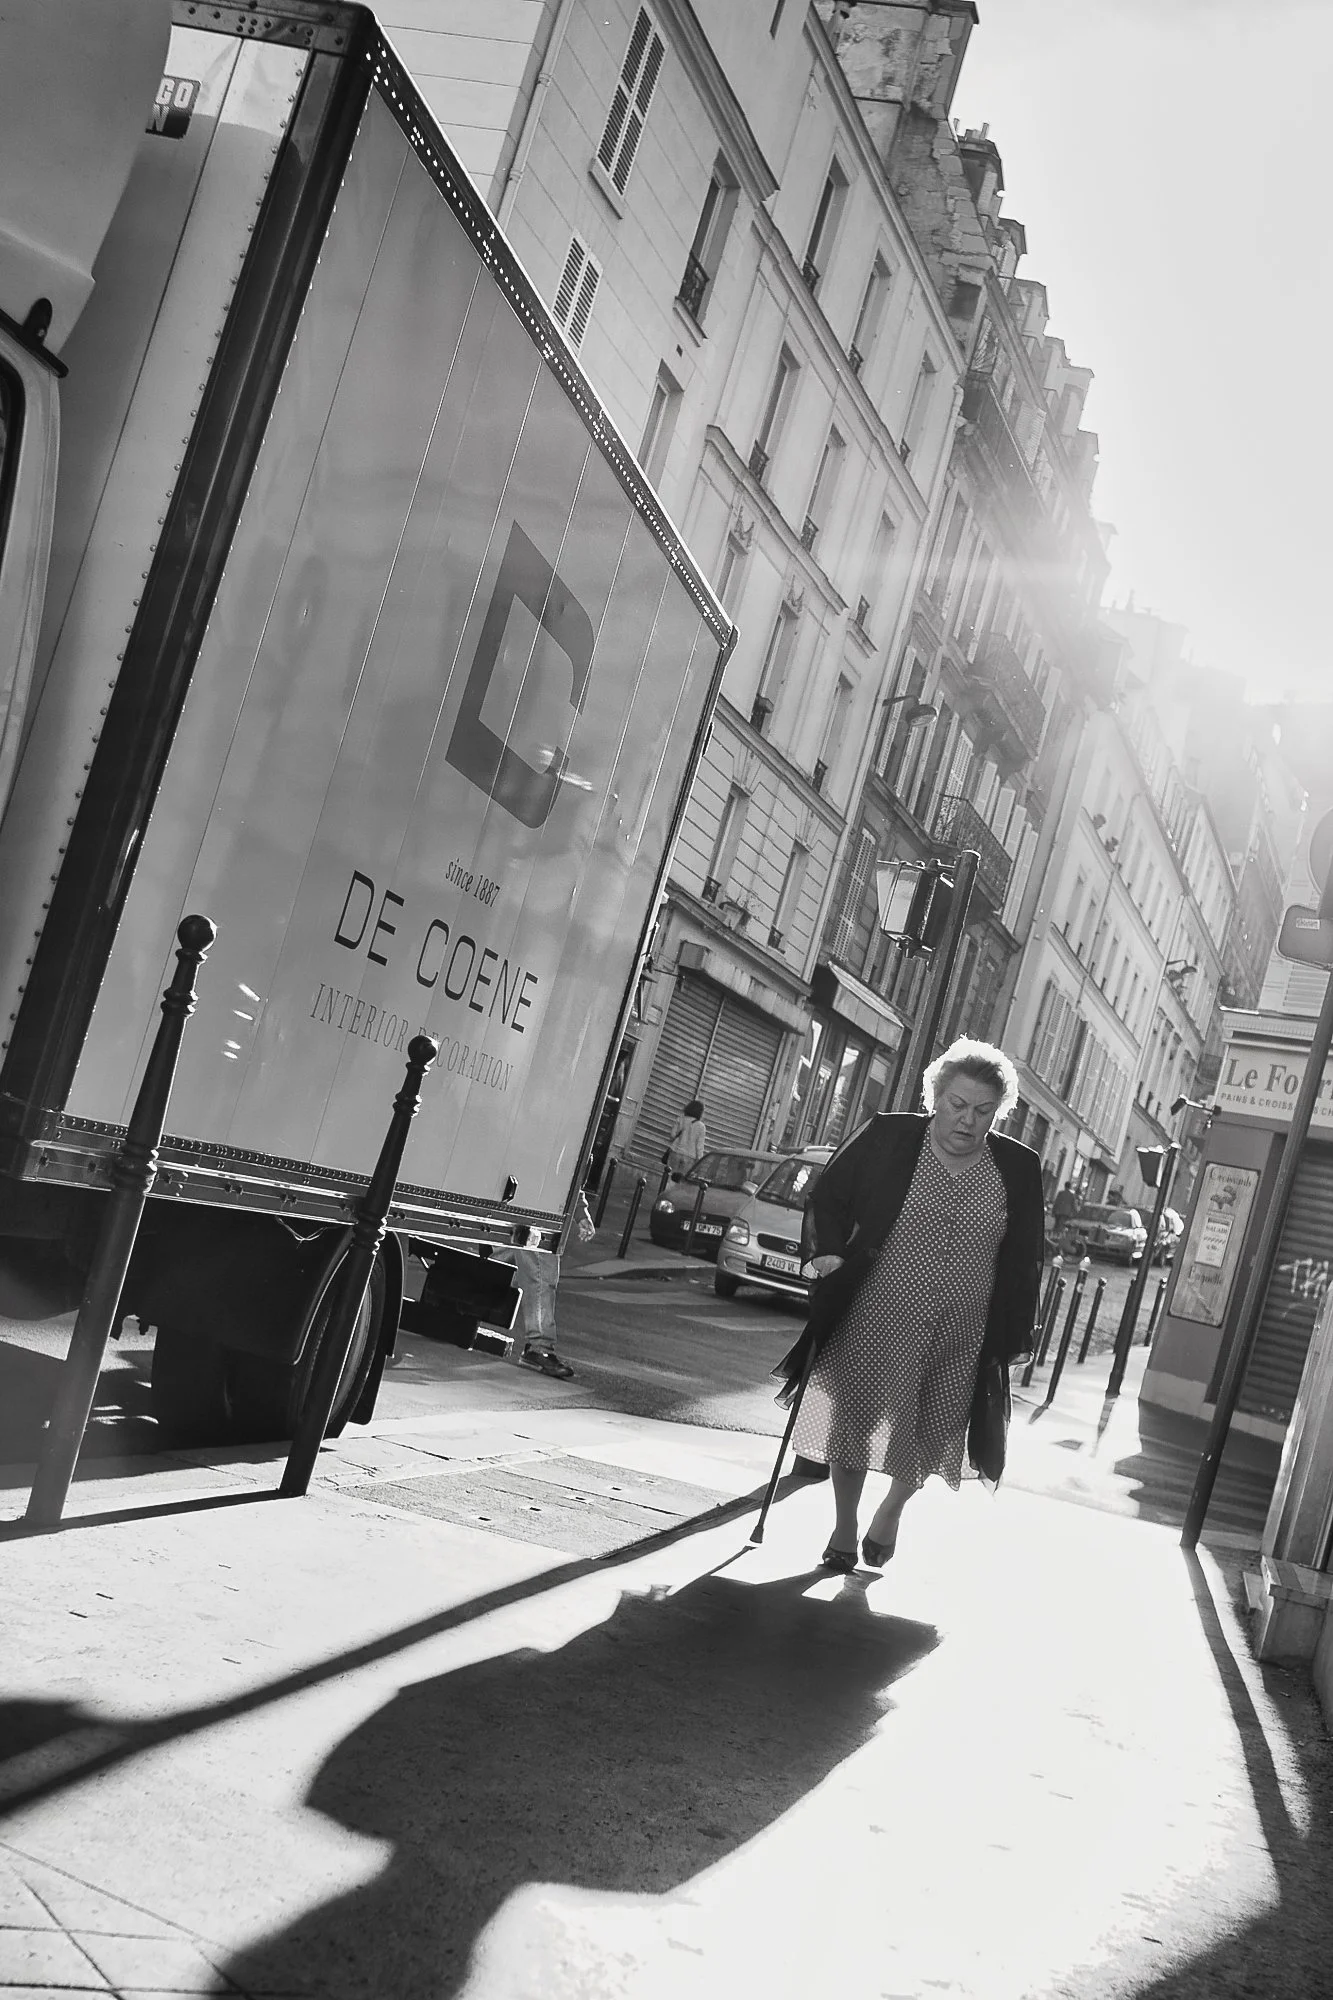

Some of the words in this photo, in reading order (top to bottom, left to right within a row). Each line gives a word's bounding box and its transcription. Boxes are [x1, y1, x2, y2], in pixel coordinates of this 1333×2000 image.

[156, 78, 195, 109] GO
[445, 858, 474, 892] since
[473, 874, 500, 908] 1887
[334, 869, 405, 967] DE
[416, 918, 539, 1034] COENE
[310, 983, 409, 1052] INTERIOR
[418, 1026, 514, 1092] CORATION
[1223, 1058, 1259, 1089] Le
[1220, 1092, 1248, 1105] PAINS
[1249, 1096, 1256, 1105] &
